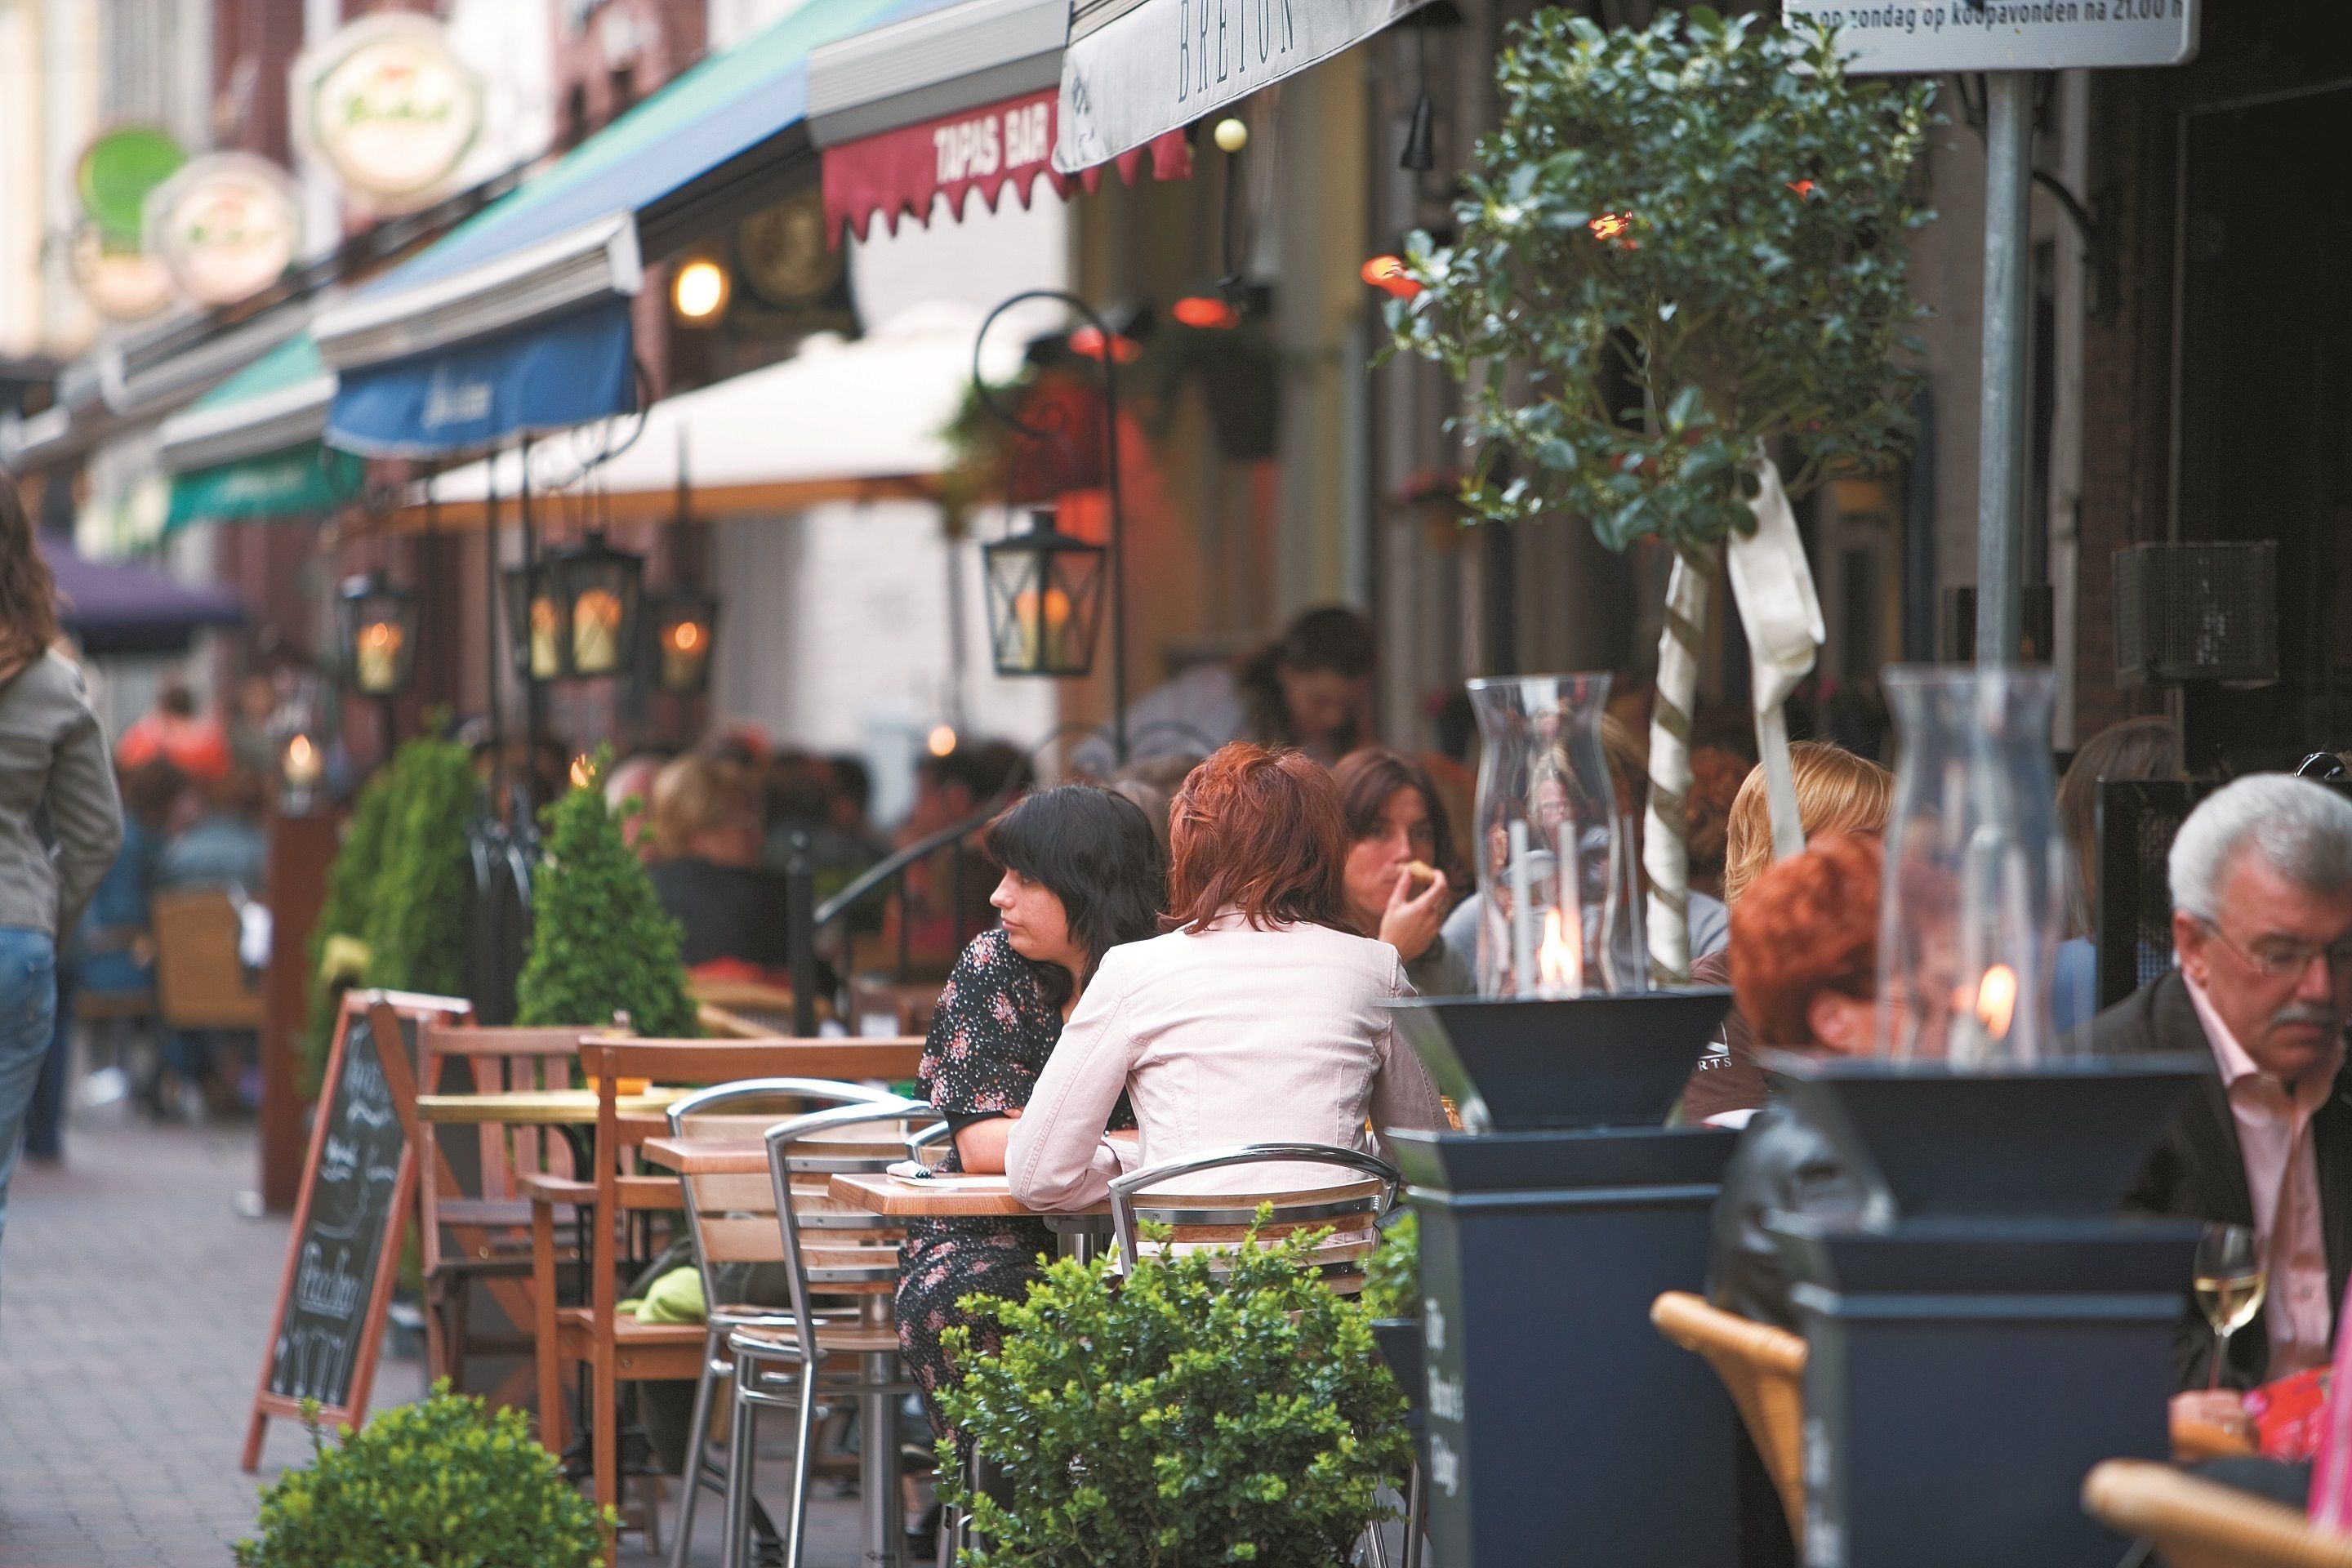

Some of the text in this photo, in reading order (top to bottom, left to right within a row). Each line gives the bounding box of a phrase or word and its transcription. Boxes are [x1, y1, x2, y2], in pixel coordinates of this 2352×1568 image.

[1923, 8, 1945, 33] op
[1952, 1, 2078, 31] koopavonden
[2084, 2, 2106, 21] na
[933, 101, 1049, 185] TAPAS BAR
[1696, 1057, 1732, 1071] RTS
